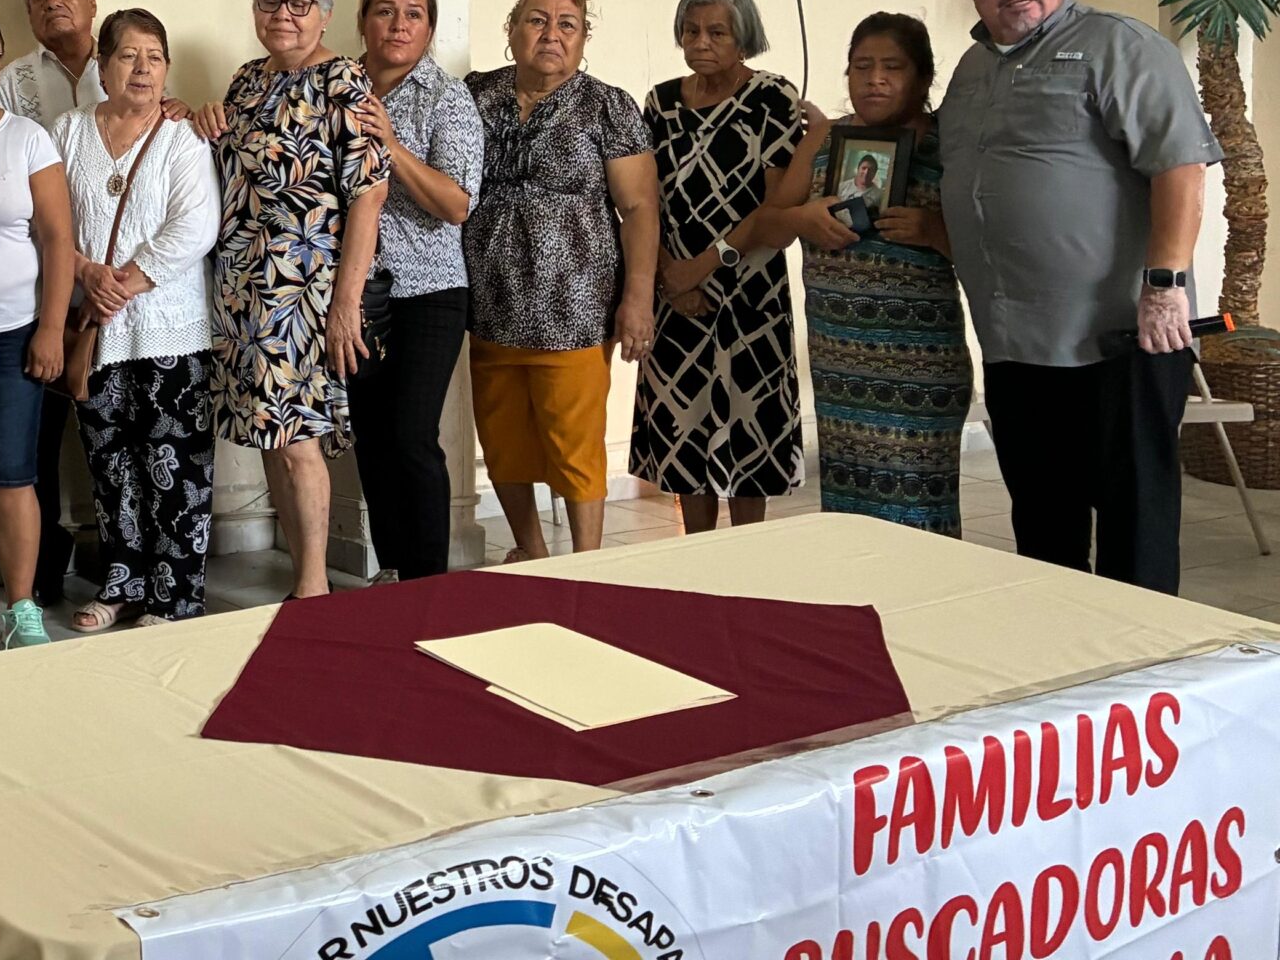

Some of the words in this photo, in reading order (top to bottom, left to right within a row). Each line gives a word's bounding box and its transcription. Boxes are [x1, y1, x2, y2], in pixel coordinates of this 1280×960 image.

[853, 692, 1181, 876] FAMILIAS
[350, 855, 554, 948] NUESTROS
[784, 806, 1246, 960] SCADORAS
